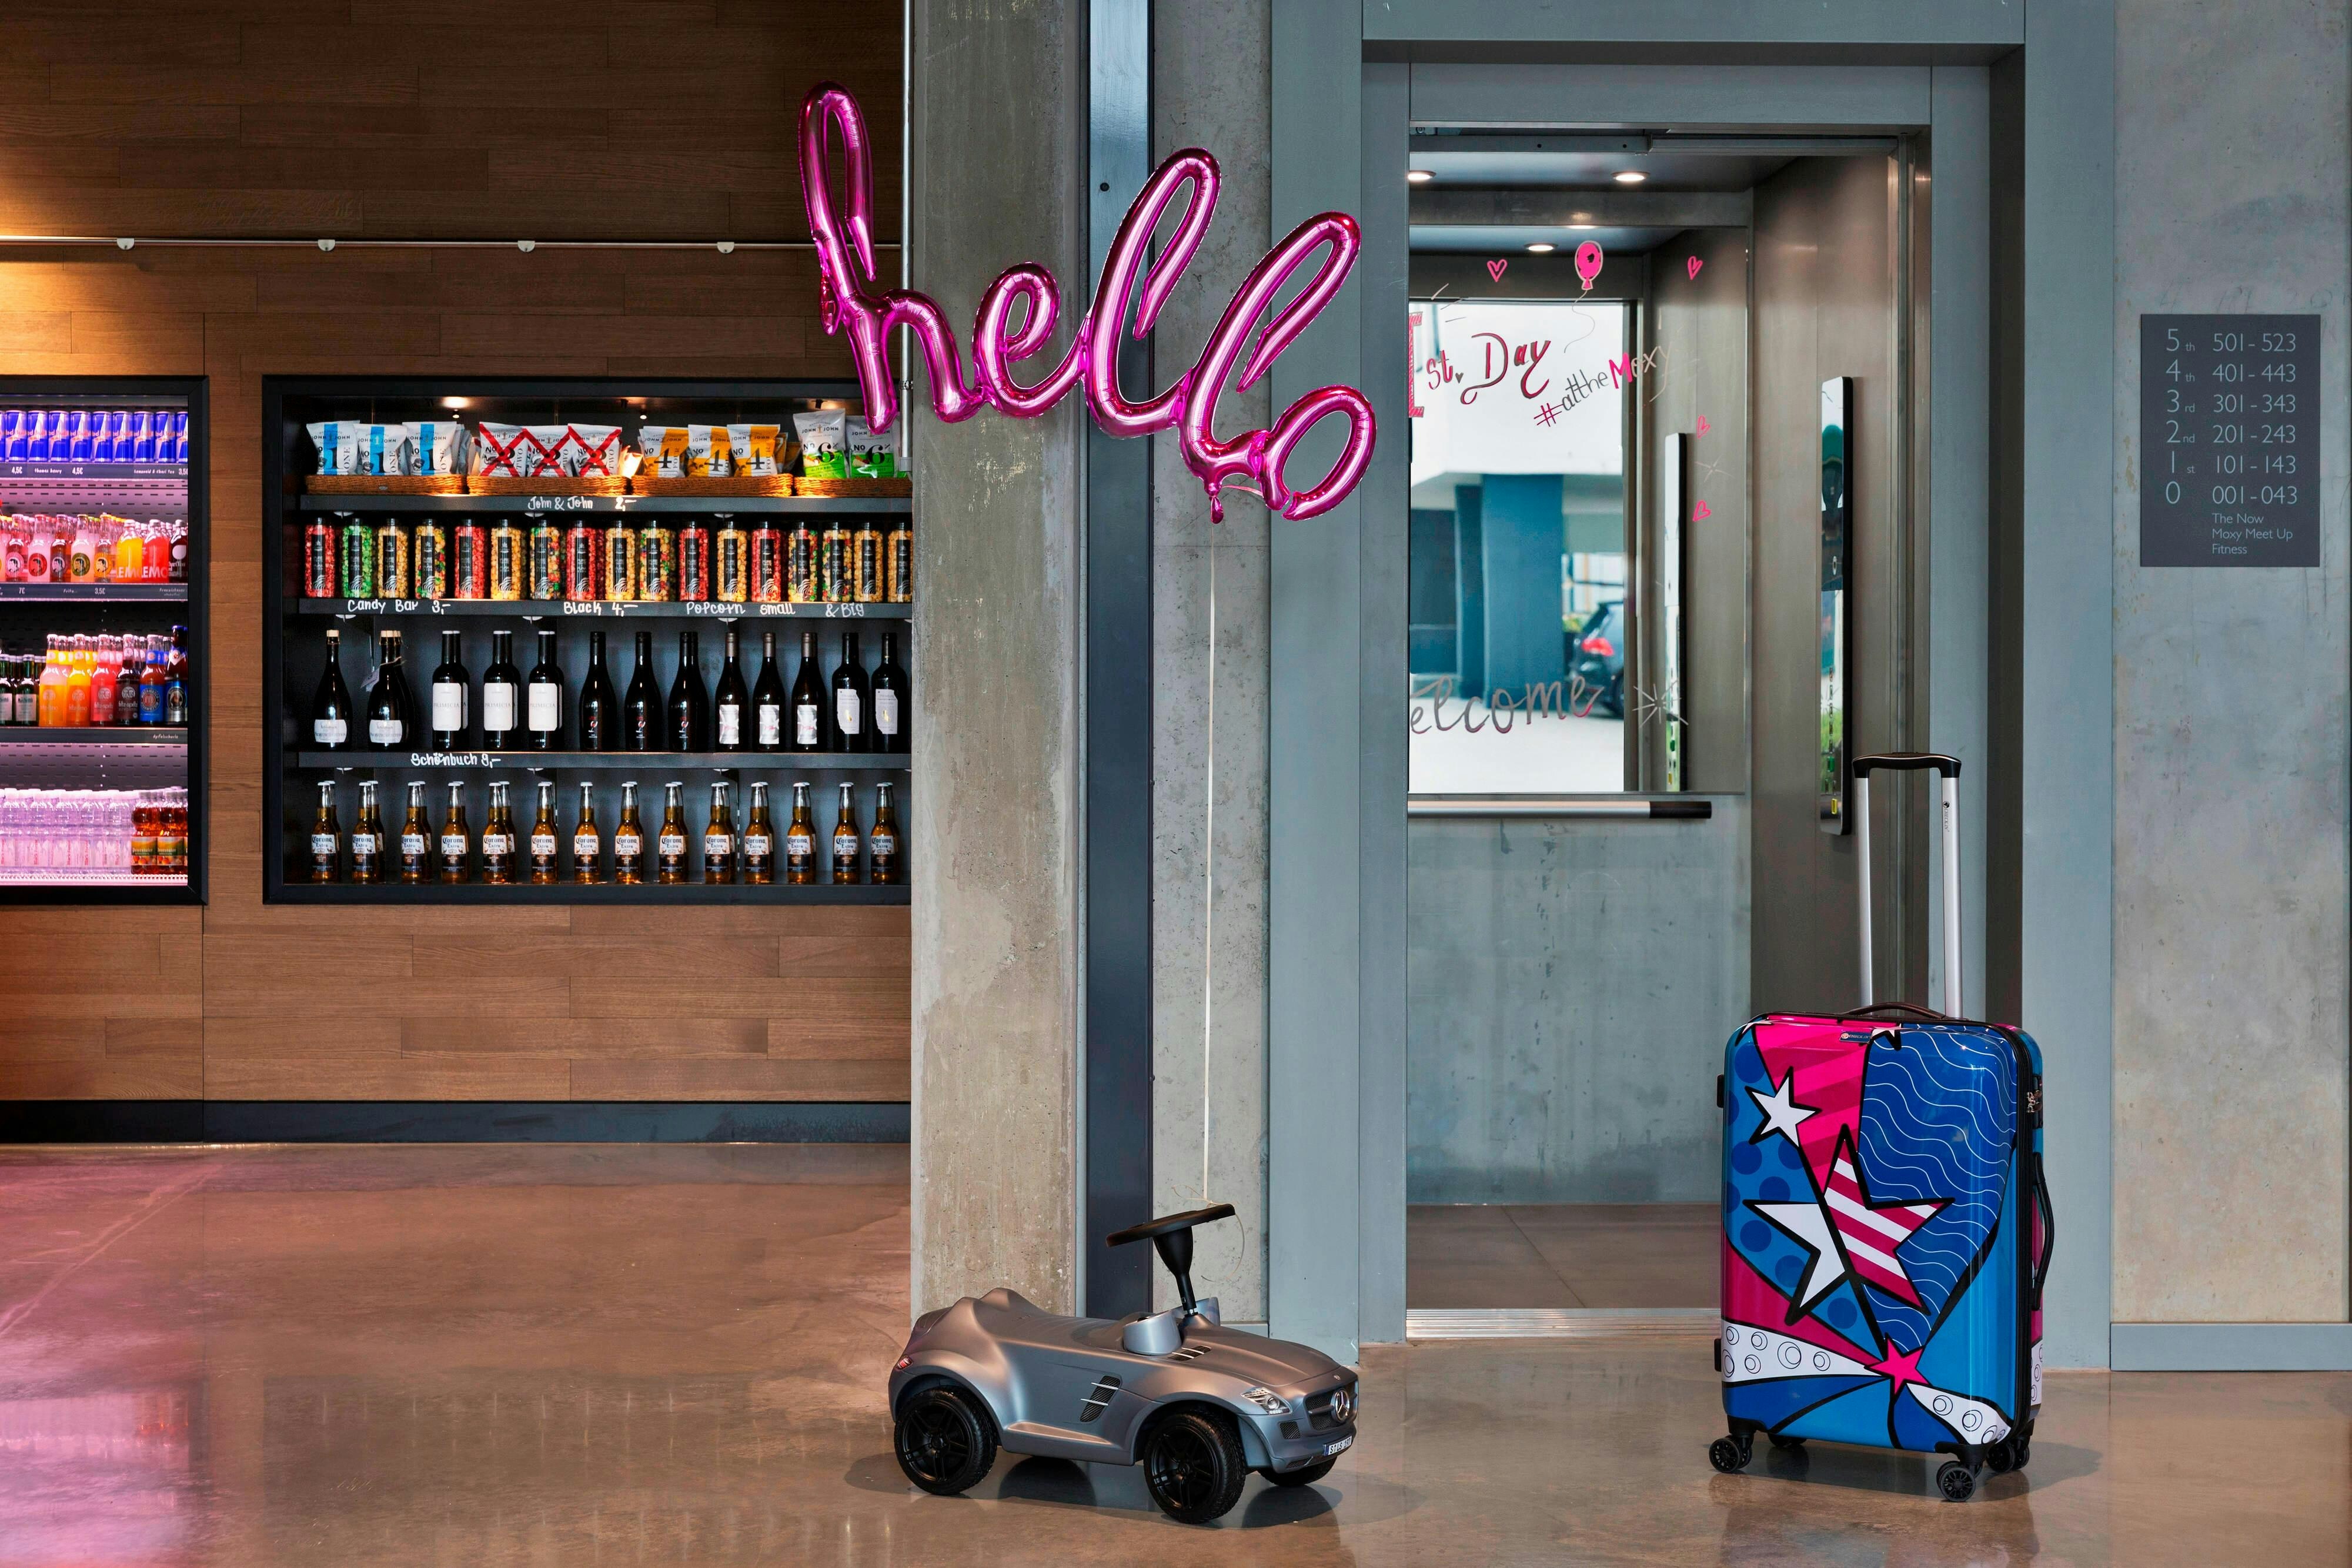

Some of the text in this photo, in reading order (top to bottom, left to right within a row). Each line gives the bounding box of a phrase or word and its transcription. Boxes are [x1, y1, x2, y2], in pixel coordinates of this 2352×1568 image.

[799, 81, 1377, 520] hello
[2166, 329, 2180, 352] 5
[2213, 333, 2244, 352] 501
[2261, 333, 2296, 352] 523
[1460, 332, 1551, 405] Day
[2166, 359, 2181, 382] 4
[2212, 364, 2244, 382] 401
[2261, 364, 2296, 382] 443
[2167, 390, 2180, 413] 3
[2213, 394, 2244, 413] 301
[2262, 394, 2296, 413] 343
[2167, 420, 2180, 443] 2
[2213, 425, 2244, 443] 201
[2261, 425, 2296, 443] 243
[2171, 451, 2175, 473] 1
[2216, 456, 2244, 474] 101
[2266, 456, 2296, 474] 143
[528, 496, 552, 510] John
[554, 496, 564, 511] &
[567, 496, 593, 509] John
[2166, 481, 2181, 504] 0
[2212, 486, 2244, 504] 001
[2261, 486, 2297, 504] 043
[2212, 513, 2264, 524] The Now
[2212, 529, 2293, 541] Moxy Meet Up
[2212, 544, 2247, 554] Fitness
[348, 599, 386, 614] Candy
[395, 599, 418, 613] Bar
[563, 601, 602, 616] Black
[759, 603, 796, 615] small
[1410, 674, 1604, 734] elcome
[410, 752, 477, 767] Schönbuch
